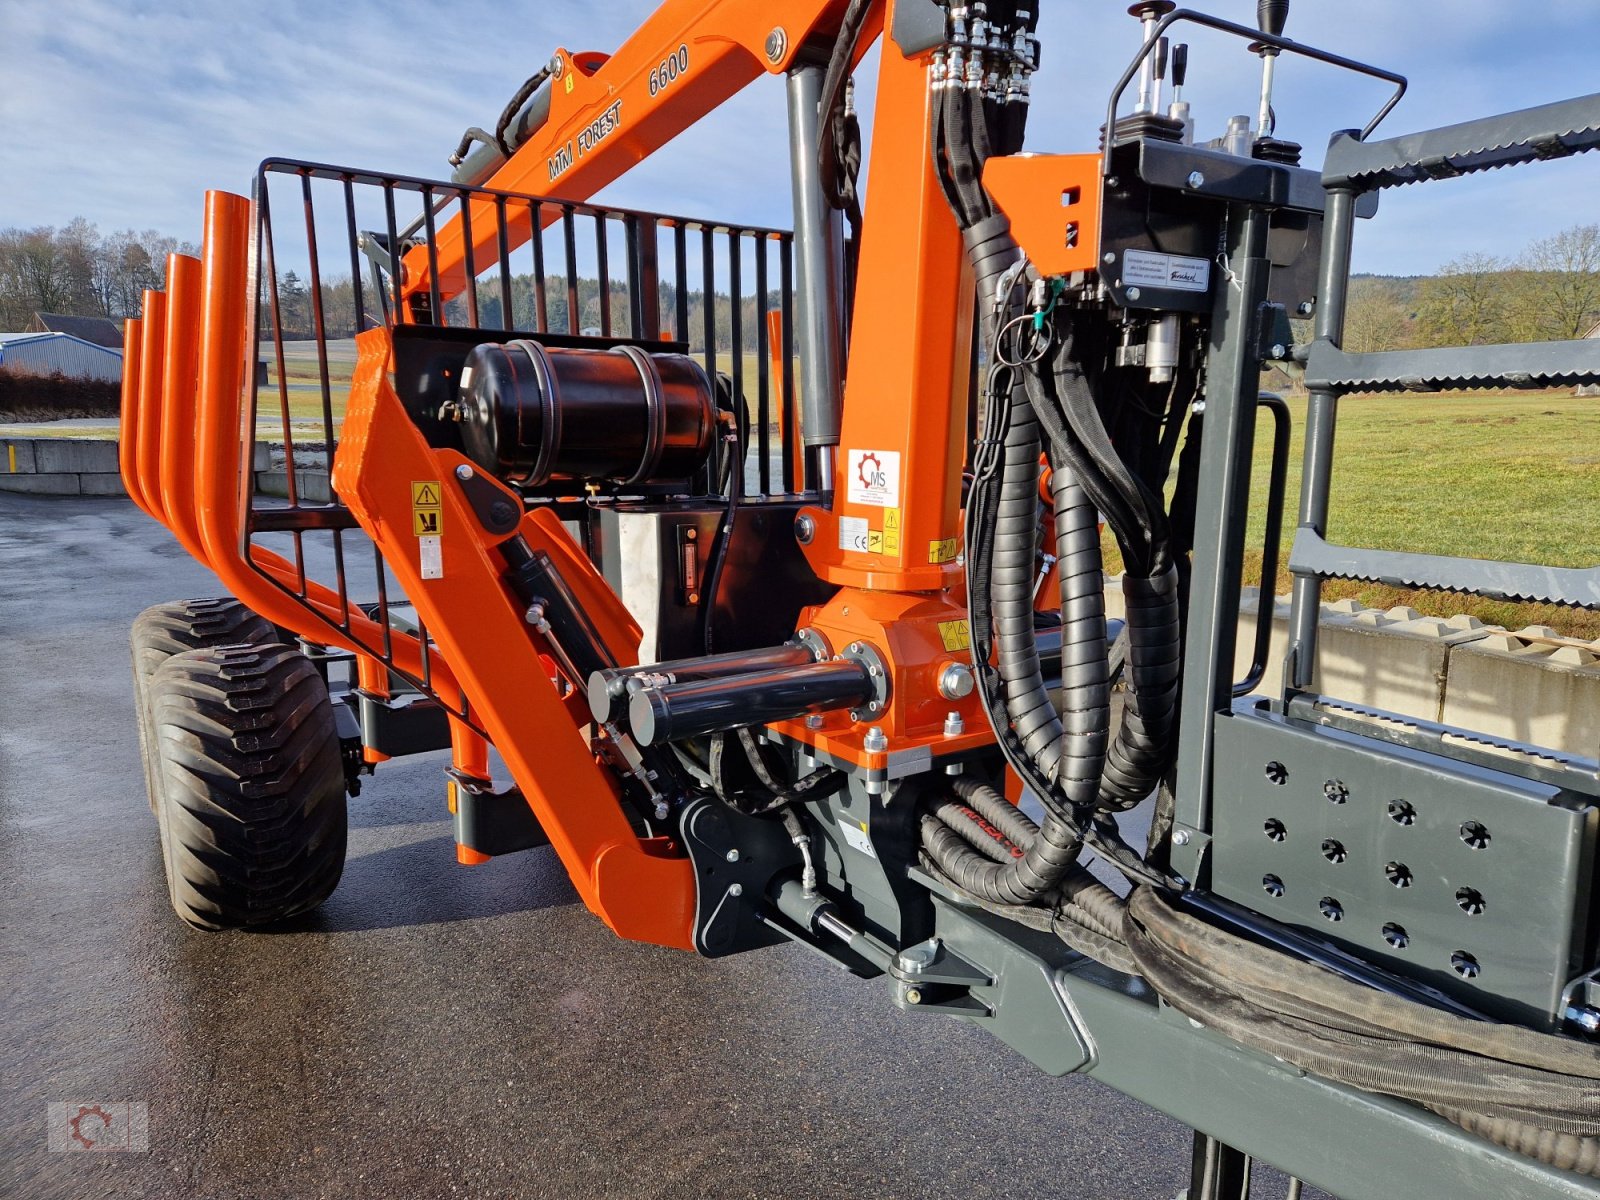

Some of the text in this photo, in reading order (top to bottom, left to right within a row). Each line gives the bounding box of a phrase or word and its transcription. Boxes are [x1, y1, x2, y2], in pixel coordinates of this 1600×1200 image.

[649, 43, 688, 96] 6600
[547, 99, 622, 182] MTM FOREST
